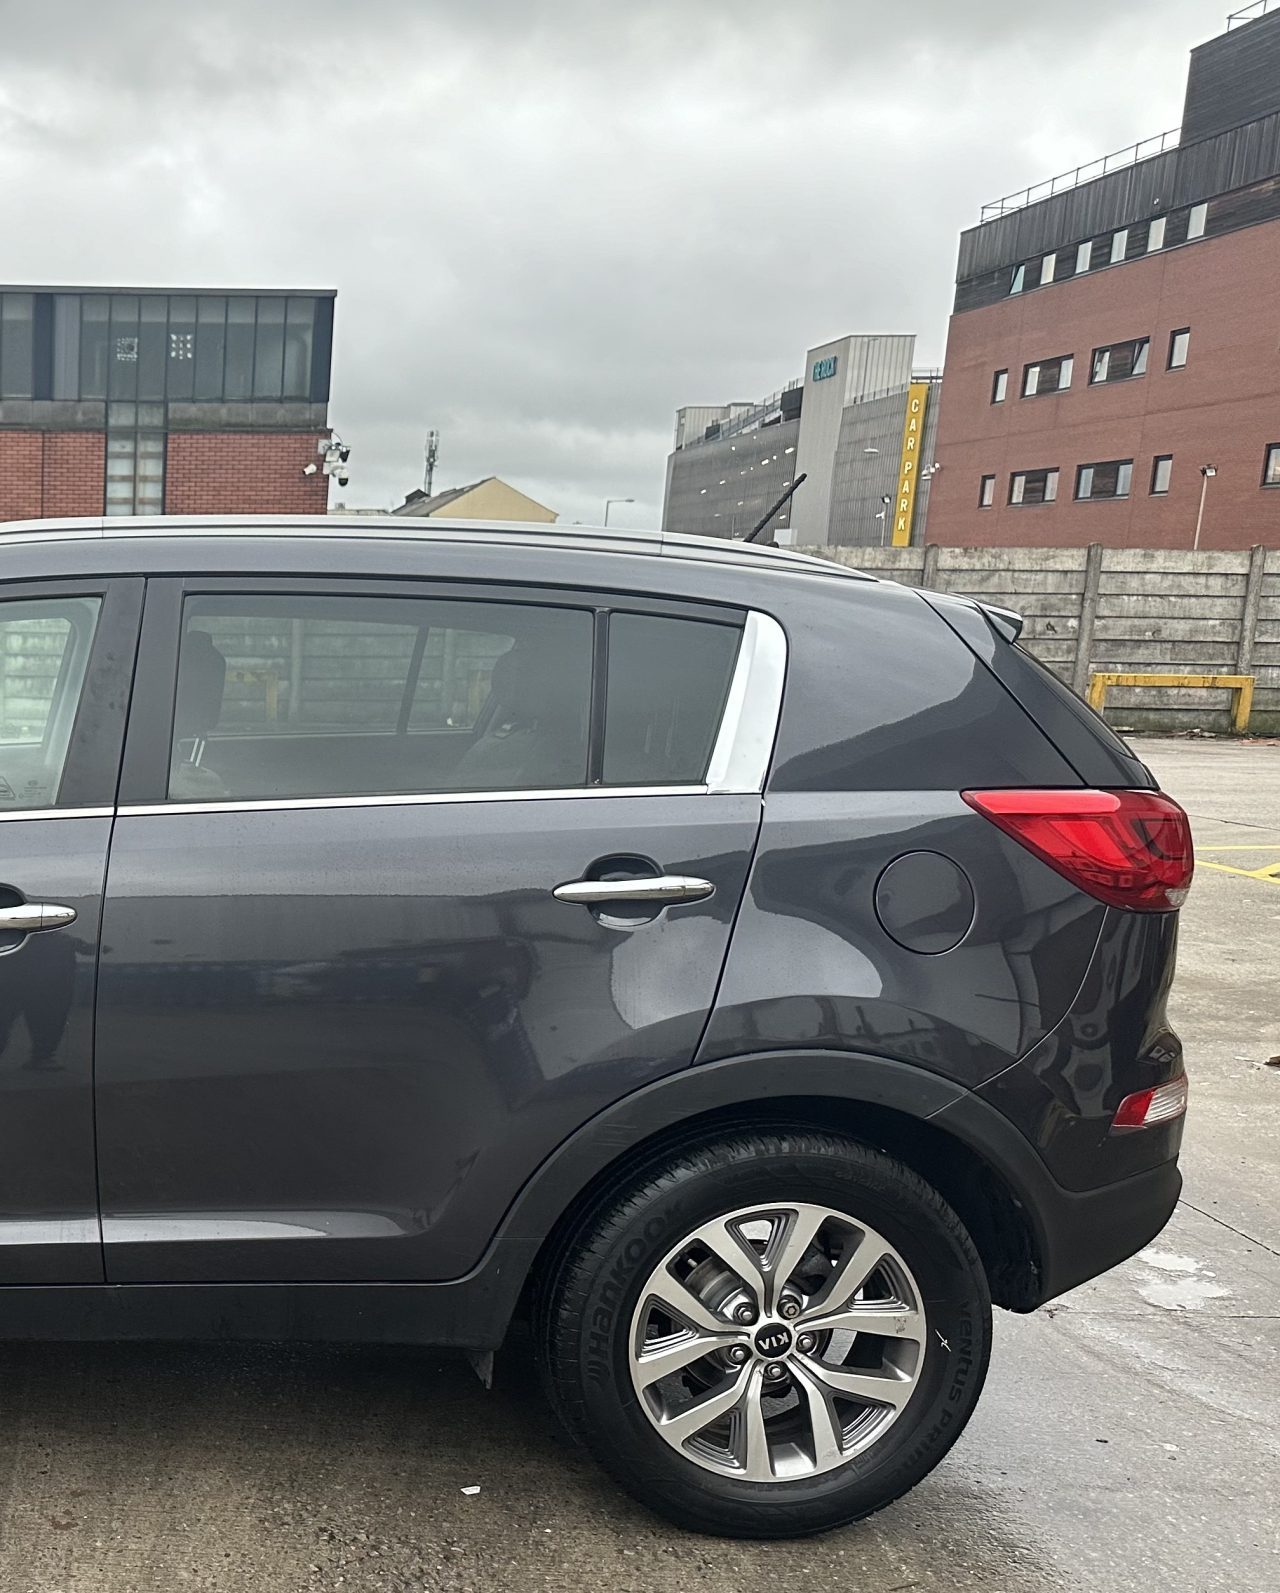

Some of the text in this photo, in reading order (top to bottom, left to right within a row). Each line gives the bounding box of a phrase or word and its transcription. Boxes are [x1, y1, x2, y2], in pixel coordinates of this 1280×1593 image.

[897, 399, 919, 530] CAR PARK
[758, 1331, 789, 1350] KIA
